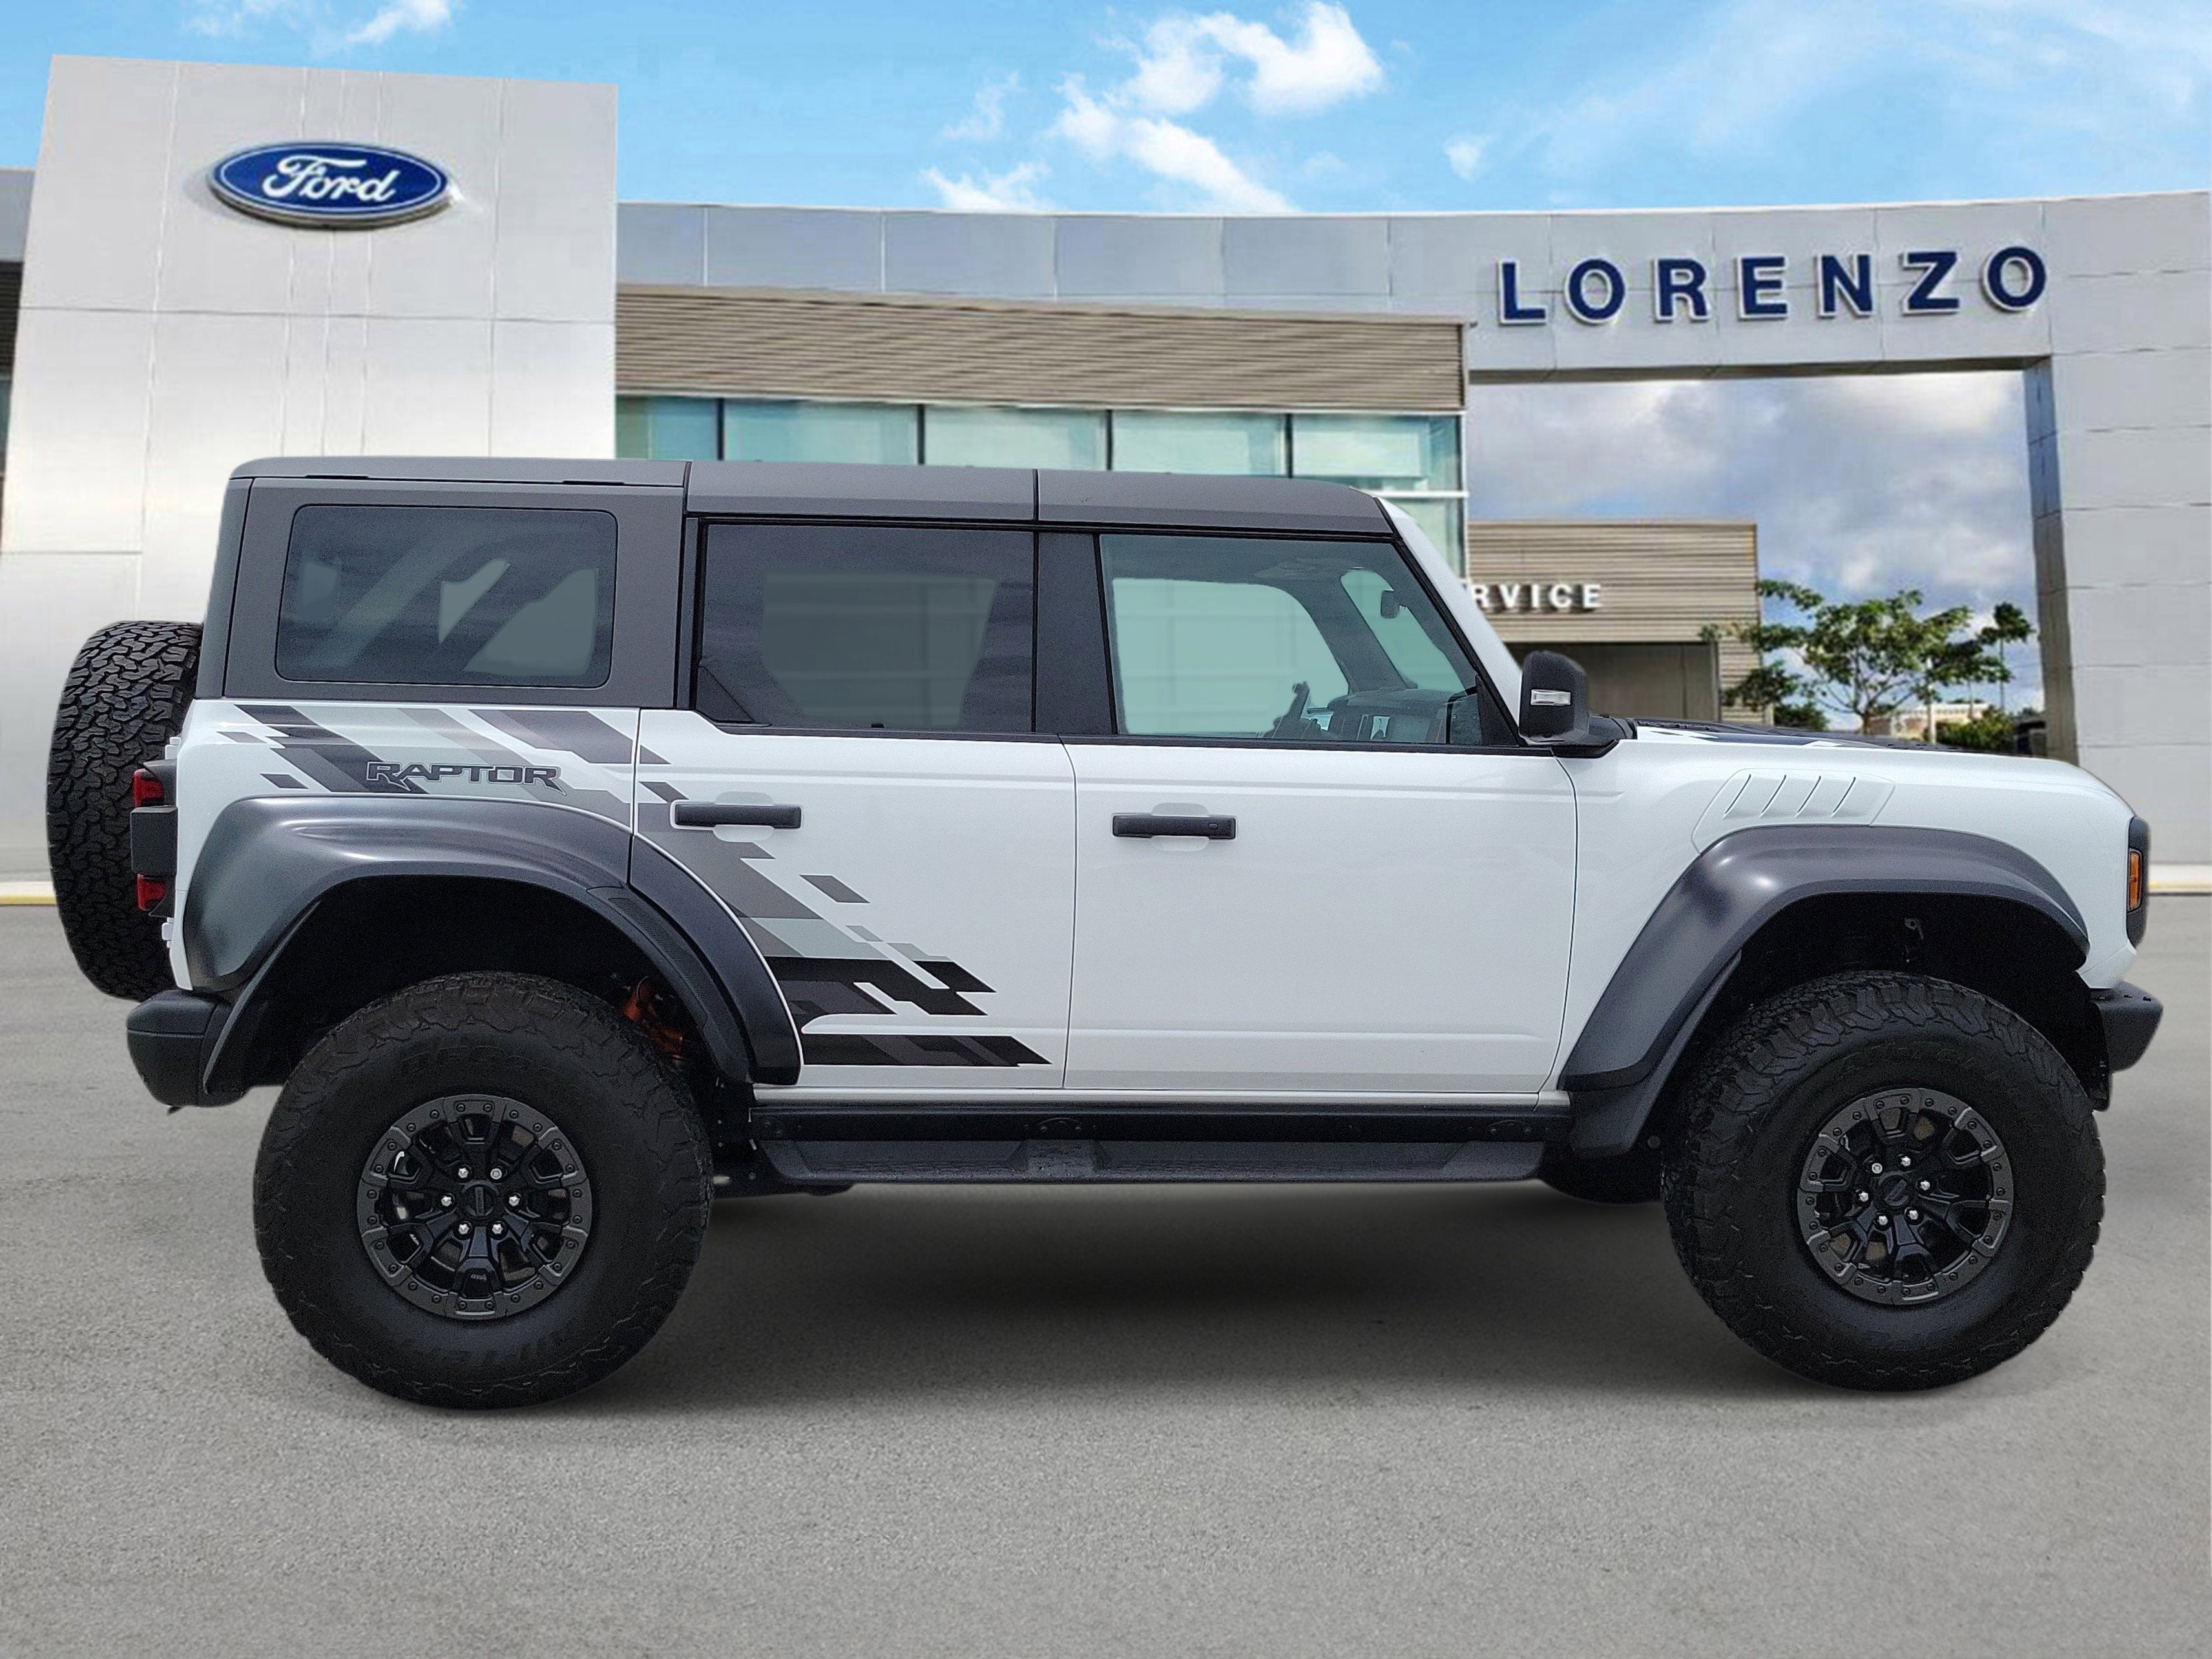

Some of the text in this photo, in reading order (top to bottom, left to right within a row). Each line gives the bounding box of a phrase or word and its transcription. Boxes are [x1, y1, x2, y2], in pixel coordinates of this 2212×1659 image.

[262, 154, 400, 202] Ford
[1499, 246, 2047, 325] LORENZO
[1470, 583, 1602, 609] RVICE
[366, 762, 567, 796] RAPTOR
